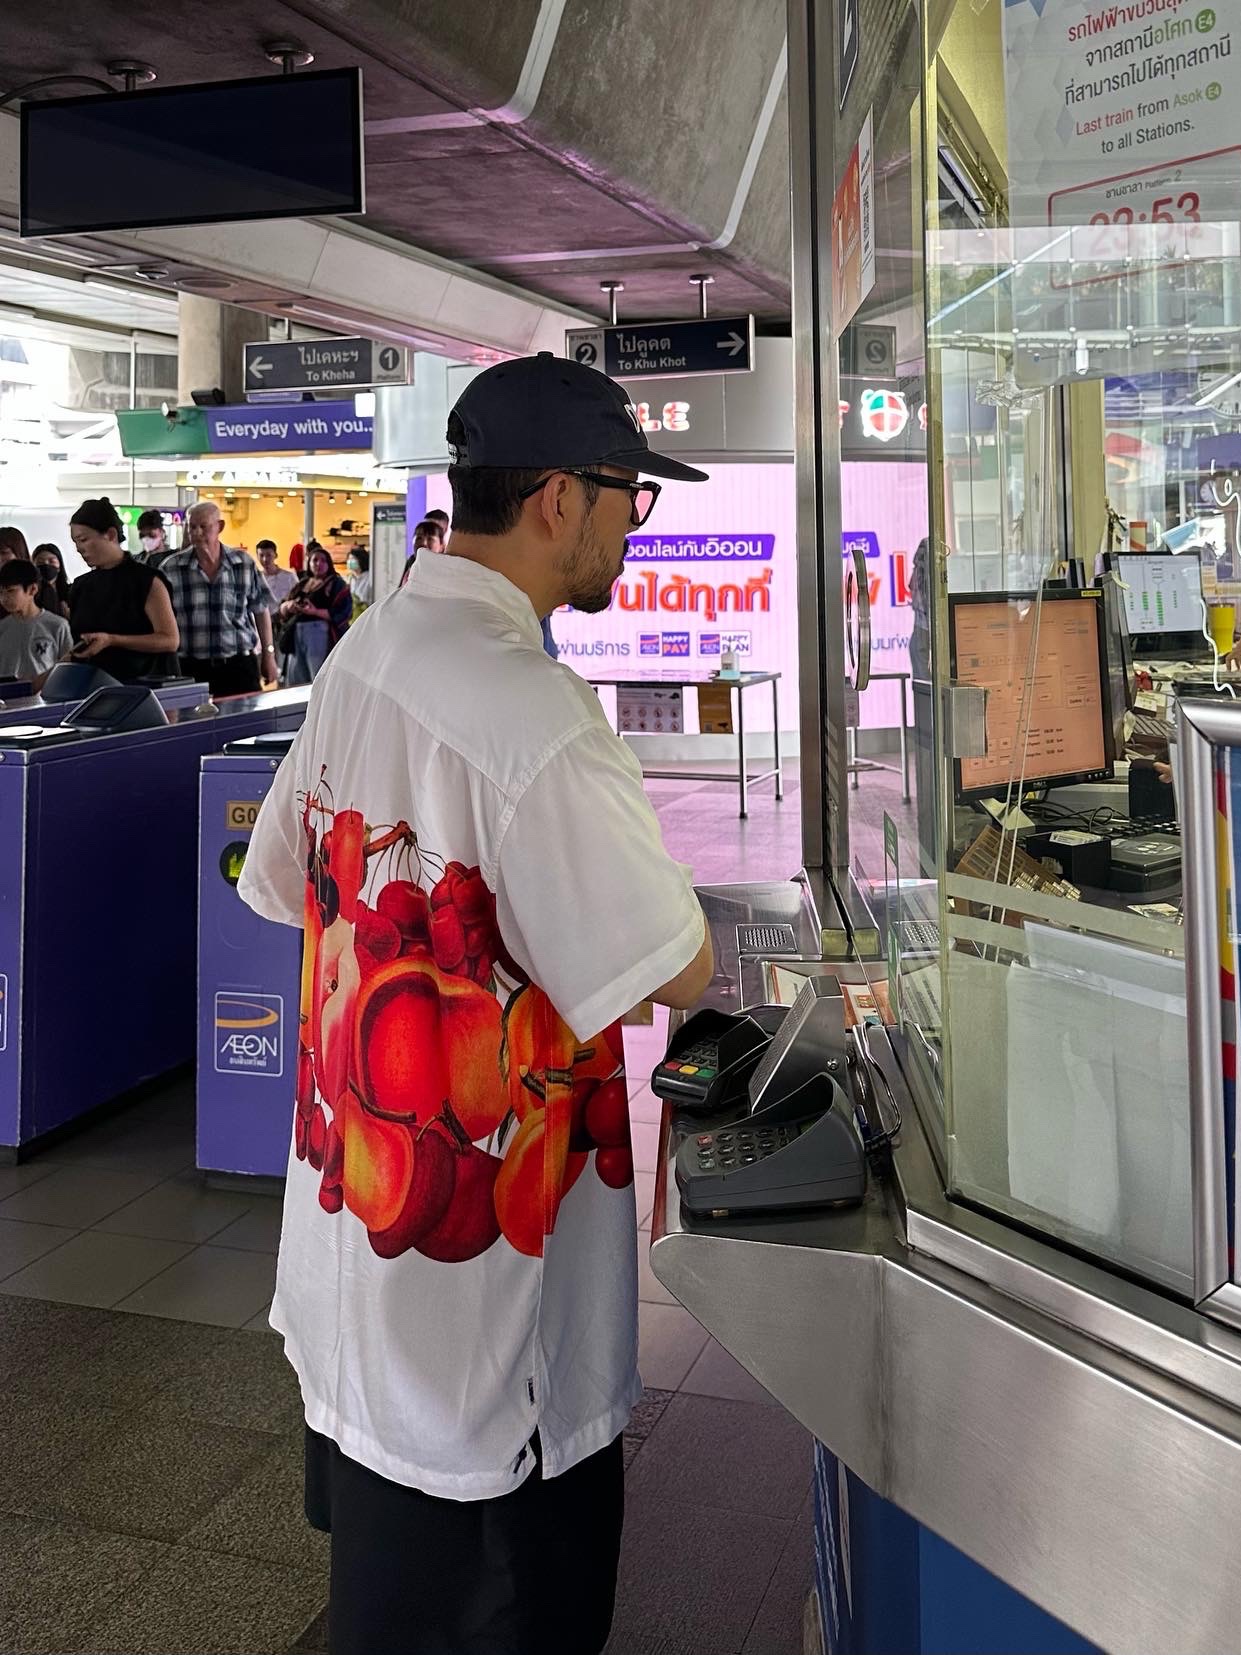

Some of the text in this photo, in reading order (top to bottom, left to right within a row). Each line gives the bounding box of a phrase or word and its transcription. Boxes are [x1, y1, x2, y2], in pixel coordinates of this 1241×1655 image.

[1065, 33, 1231, 106] ที่สามารถไปได้ทุกสถานี
[1076, 118, 1102, 136] Last
[1104, 108, 1134, 128] train
[1137, 98, 1169, 119] from
[1173, 88, 1203, 108] Asok
[1101, 119, 1195, 153] to all Stations.
[1175, 169, 1182, 182] 2
[617, 332, 671, 358] ไปคูคต
[298, 346, 359, 365] ไปเคหะฯ
[618, 356, 686, 371] To Khu Khot
[306, 369, 355, 381] To Kheha
[215, 420, 288, 439] Everyday
[294, 418, 328, 435] with
[662, 635, 689, 643] HAPPY
[663, 644, 689, 654] PAY
